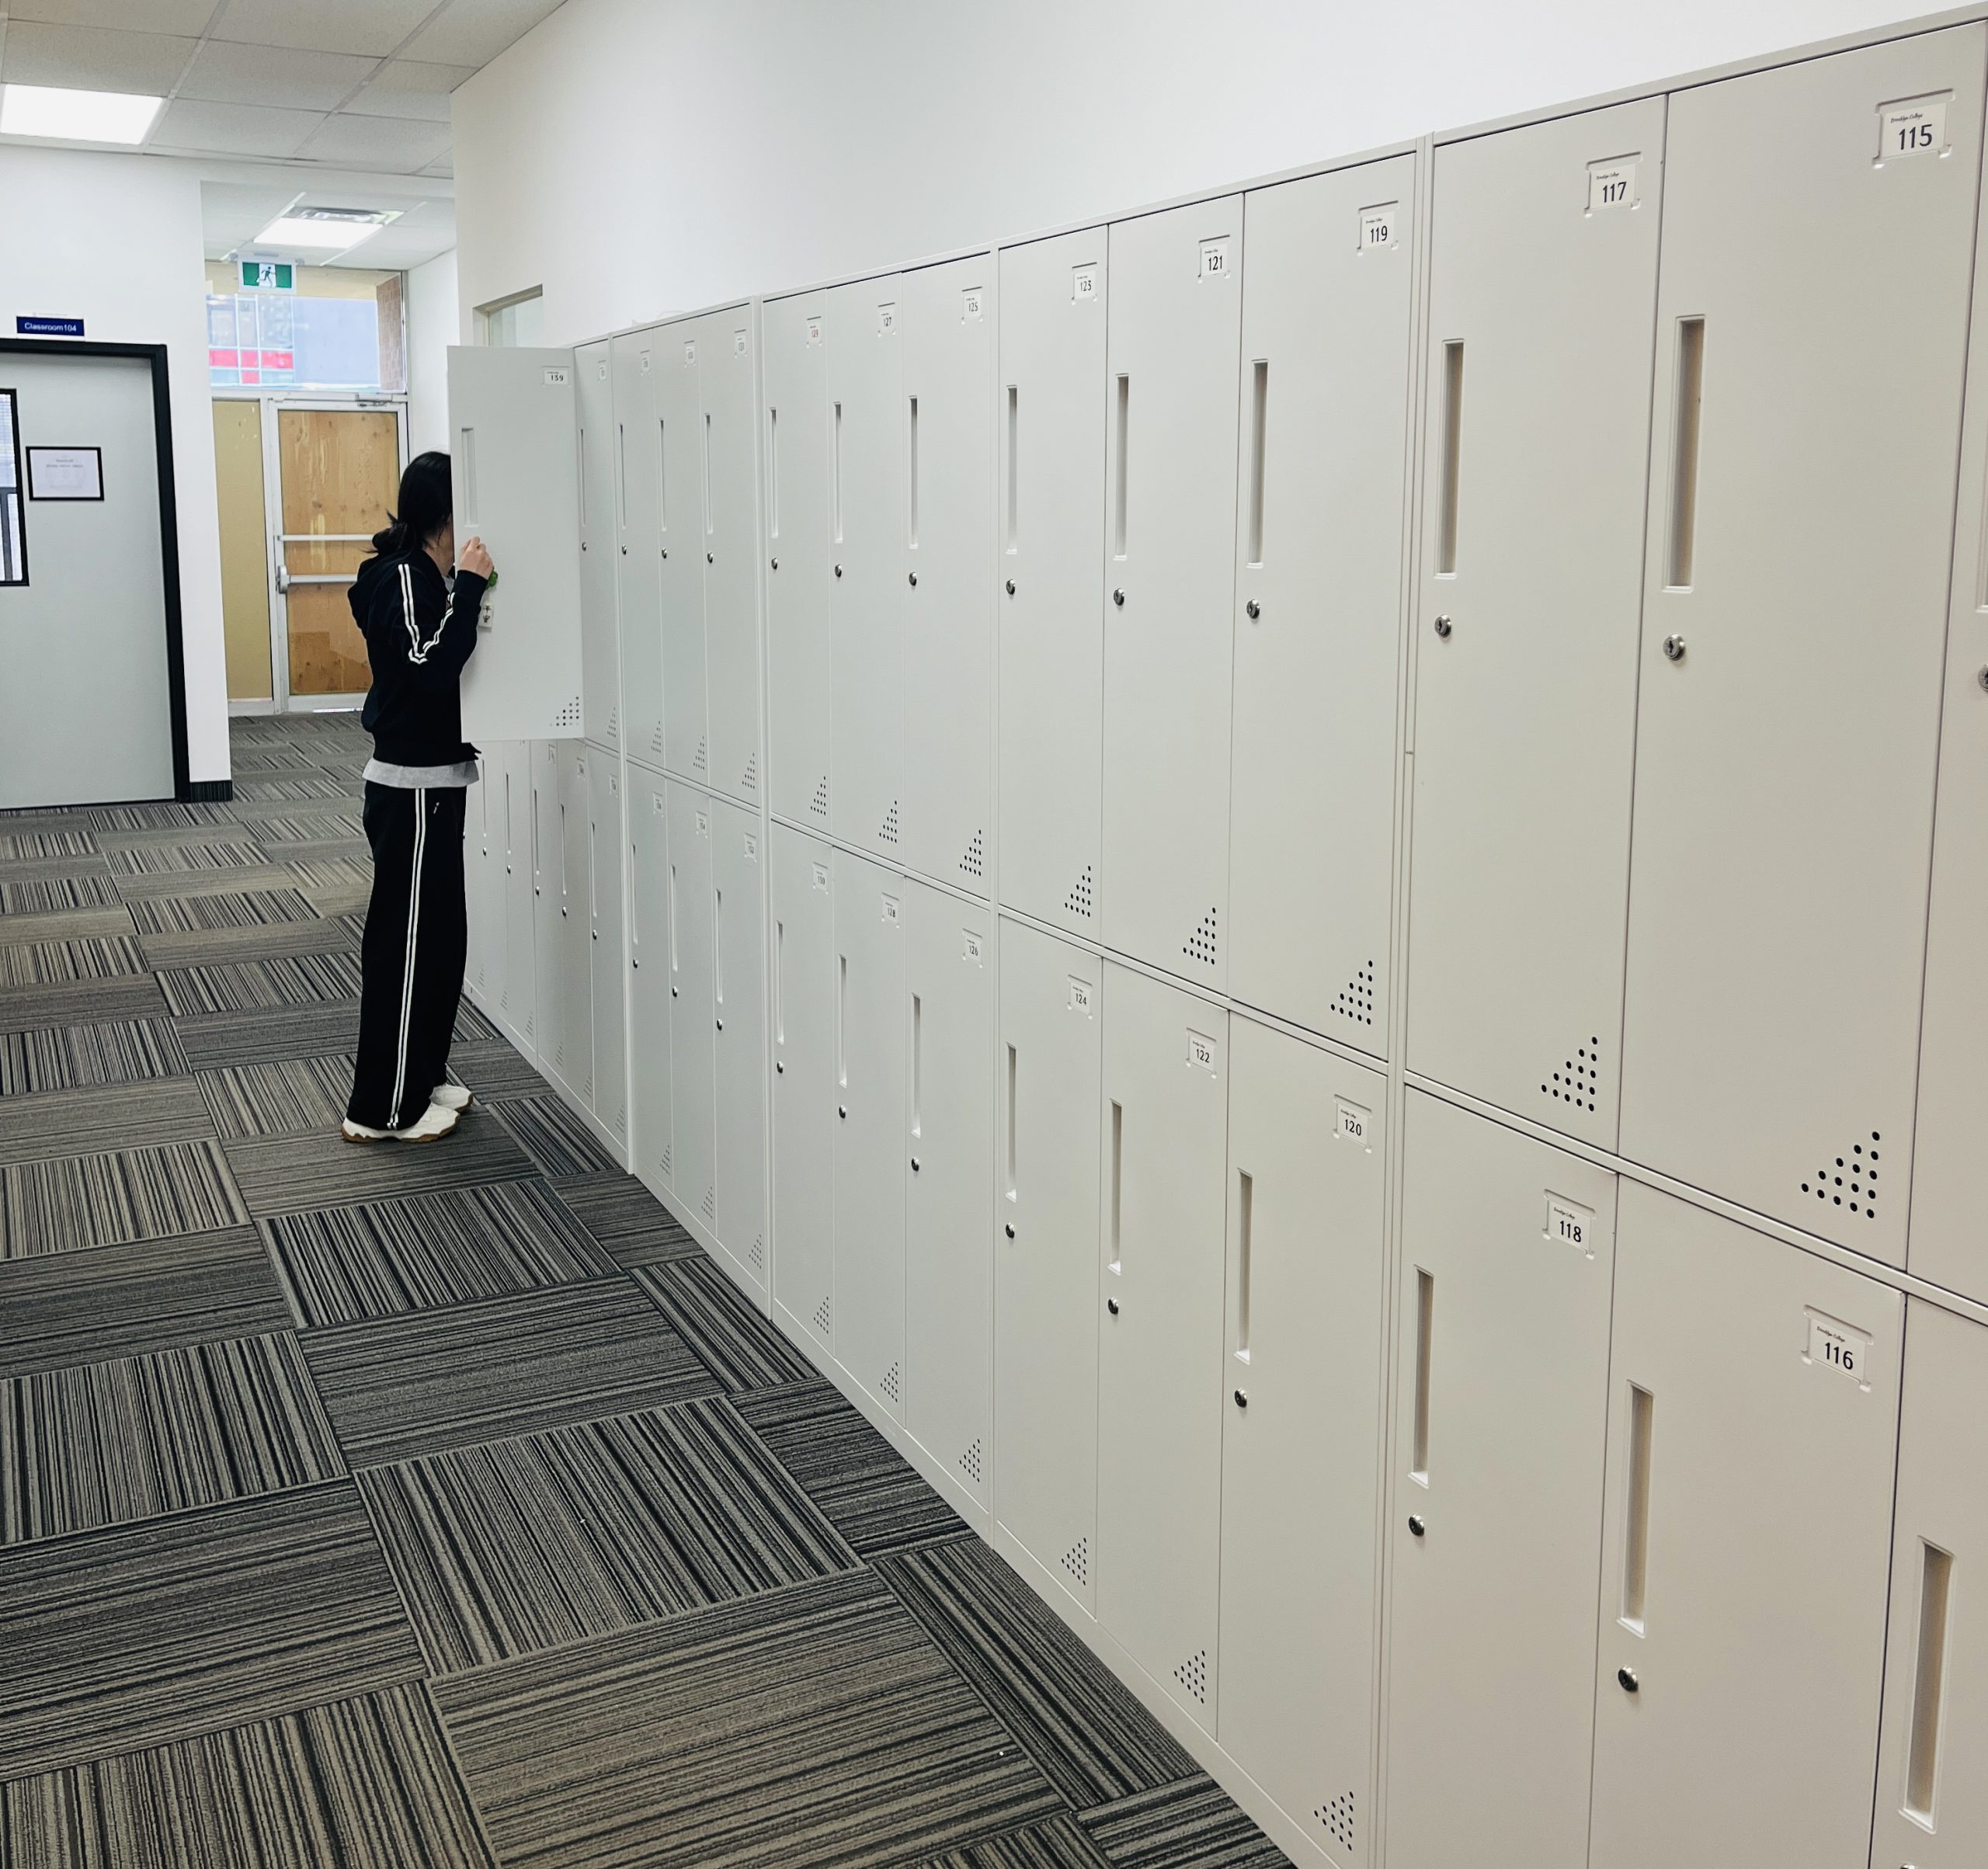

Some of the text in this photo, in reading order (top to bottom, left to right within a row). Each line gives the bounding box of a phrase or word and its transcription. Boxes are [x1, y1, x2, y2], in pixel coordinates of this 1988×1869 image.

[1899, 123, 1933, 151] 115
[1602, 181, 1628, 203] 117
[1370, 225, 1388, 243] 119
[1208, 255, 1223, 271] 121
[1080, 280, 1092, 292] 123
[968, 301, 978, 312] 125
[883, 316, 892, 326] 127
[969, 945, 978, 956] 126
[1076, 993, 1087, 1006] 124
[1196, 1048, 1210, 1063] 122
[1345, 1118, 1362, 1137] 120
[1559, 1220, 1582, 1242] 118
[1824, 1342, 1854, 1370] 116
